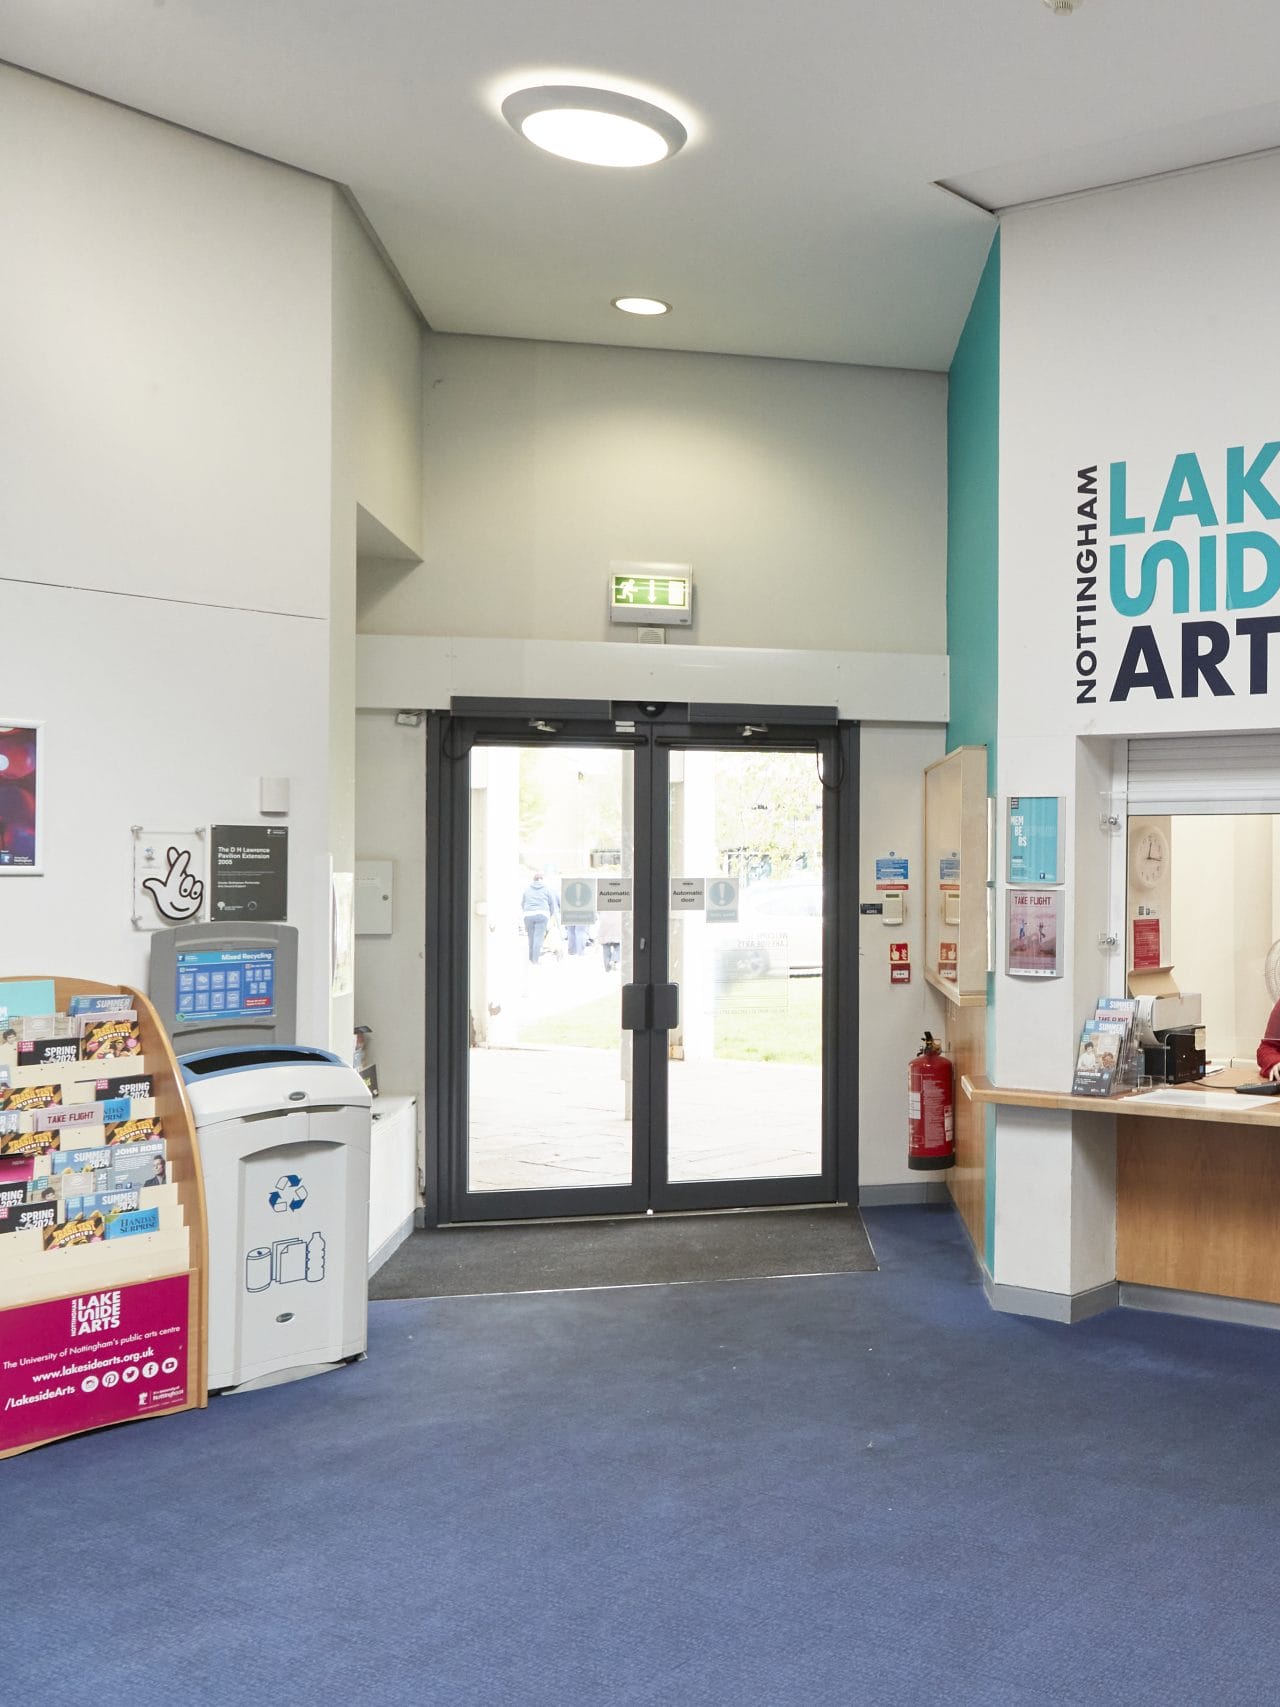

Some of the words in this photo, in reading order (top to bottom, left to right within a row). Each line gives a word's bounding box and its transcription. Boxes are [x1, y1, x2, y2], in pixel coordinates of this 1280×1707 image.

[1076, 465, 1098, 704] NOTTINGHAM
[1014, 896, 1028, 905] TAKE
[1030, 896, 1052, 906] FLIGHT
[96, 999, 131, 1008] SUMMER
[44, 1046, 77, 1057] SPRING
[118, 1082, 150, 1094] SPRING
[48, 1114, 66, 1124] TAKE
[69, 1111, 94, 1122] FLIGHT
[74, 1149, 112, 1162] SUMMER
[116, 1146, 138, 1156] JOHN
[140, 1144, 163, 1152] ROBB
[0, 1190, 24, 1202] RING
[102, 1191, 138, 1205] SUMMER
[20, 1208, 55, 1223] SPRING
[120, 1222, 156, 1233] SURPRISE
[78, 1290, 120, 1310] LAKE
[78, 1315, 120, 1336] ARTS
[3, 1361, 17, 1370] The
[20, 1353, 56, 1367] University
[59, 1348, 68, 1357] of
[70, 1338, 119, 1355] Nottingham's
[120, 1333, 142, 1346] public
[144, 1331, 158, 1340] arts
[158, 1326, 180, 1336] centre
[32, 1346, 154, 1383] www.lakesidearts.org.uk
[4, 1384, 76, 1411] /LakesideArts
